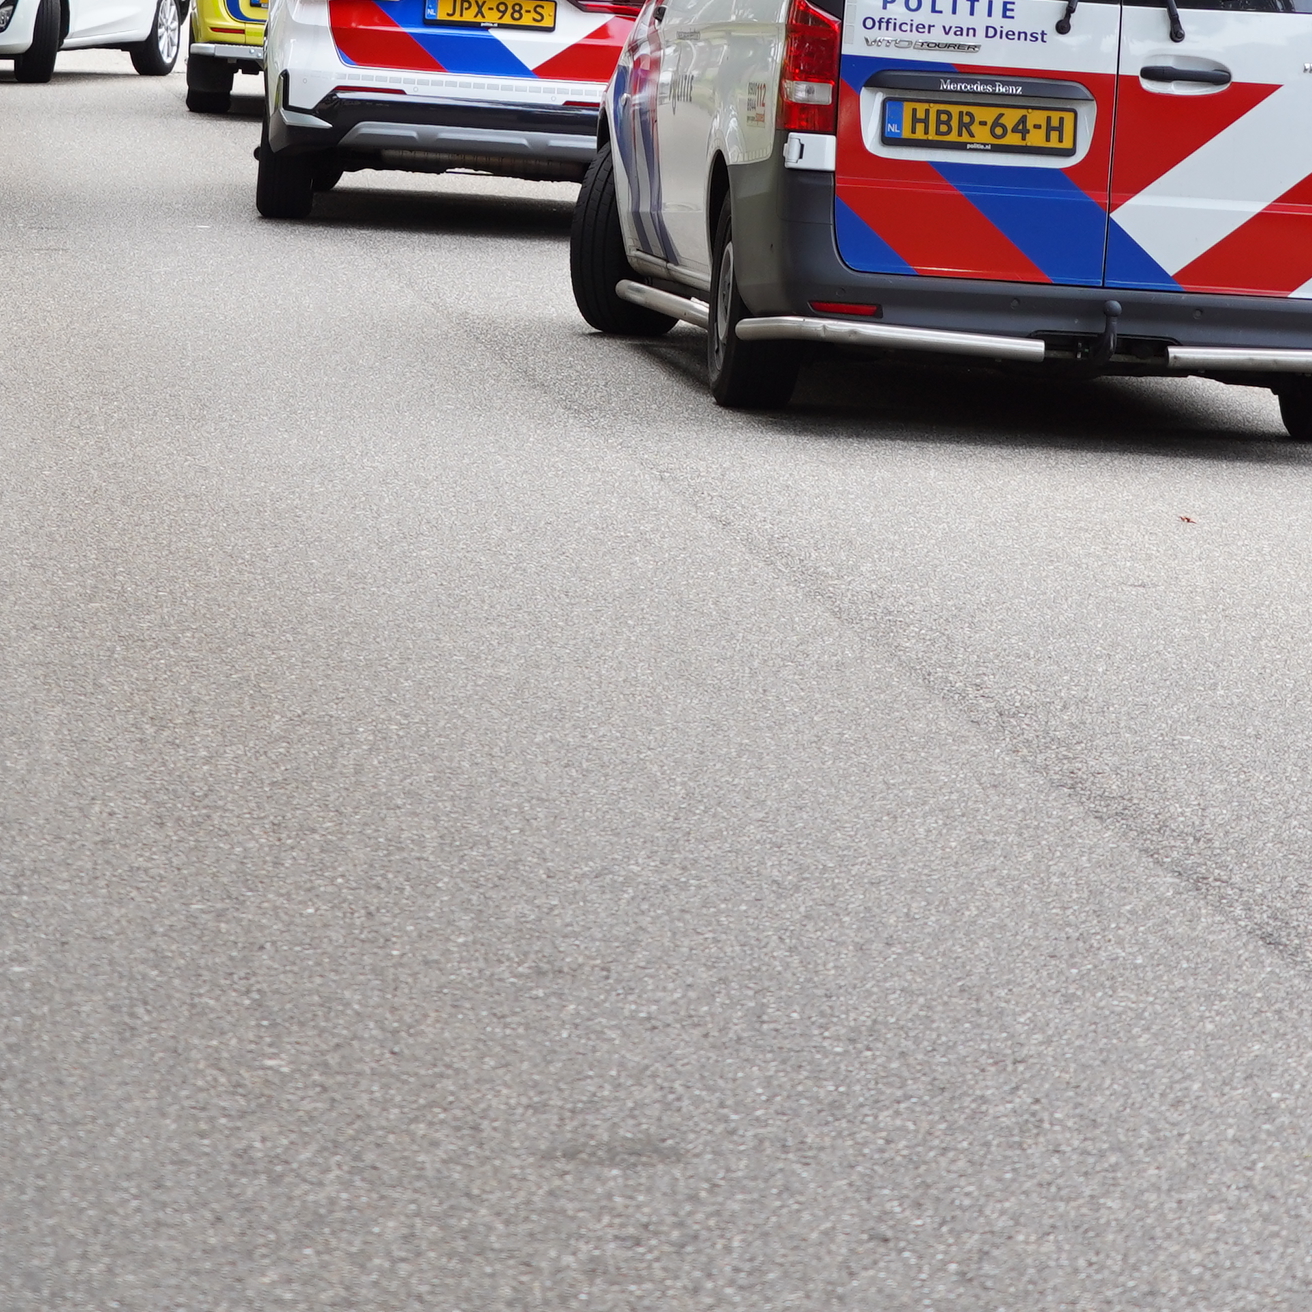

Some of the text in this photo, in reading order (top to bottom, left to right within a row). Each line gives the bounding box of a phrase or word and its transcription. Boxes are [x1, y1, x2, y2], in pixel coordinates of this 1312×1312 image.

[427, 8, 437, 17] NL
[862, 16, 1048, 44] Officier van Dienst
[919, 41, 979, 52] TOURER
[939, 78, 1023, 95] Mercedes-Benz
[887, 123, 900, 133] NL
[911, 107, 1065, 143] HBR-64-H
